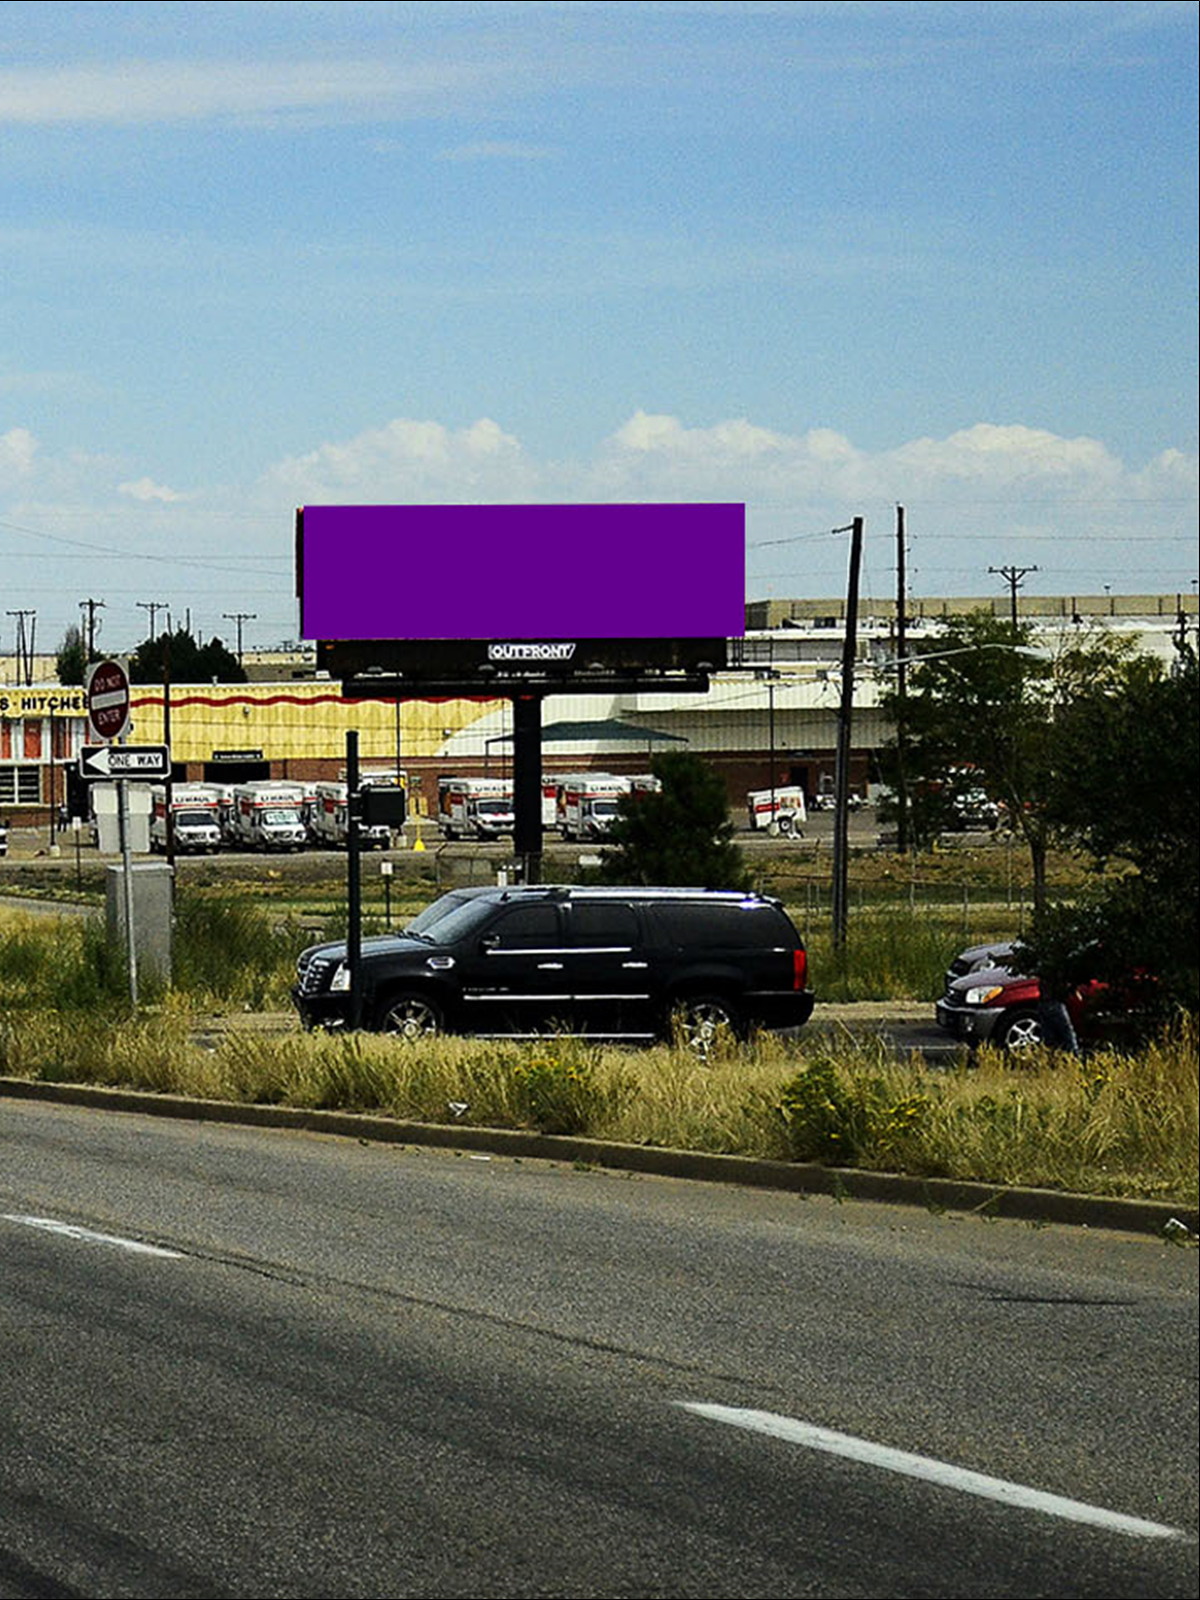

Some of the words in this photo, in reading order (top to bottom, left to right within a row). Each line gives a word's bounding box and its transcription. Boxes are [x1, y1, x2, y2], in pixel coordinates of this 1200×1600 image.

[98, 709, 121, 726] ENTER
[108, 754, 131, 768] ONE
[136, 755, 161, 767] WAY
